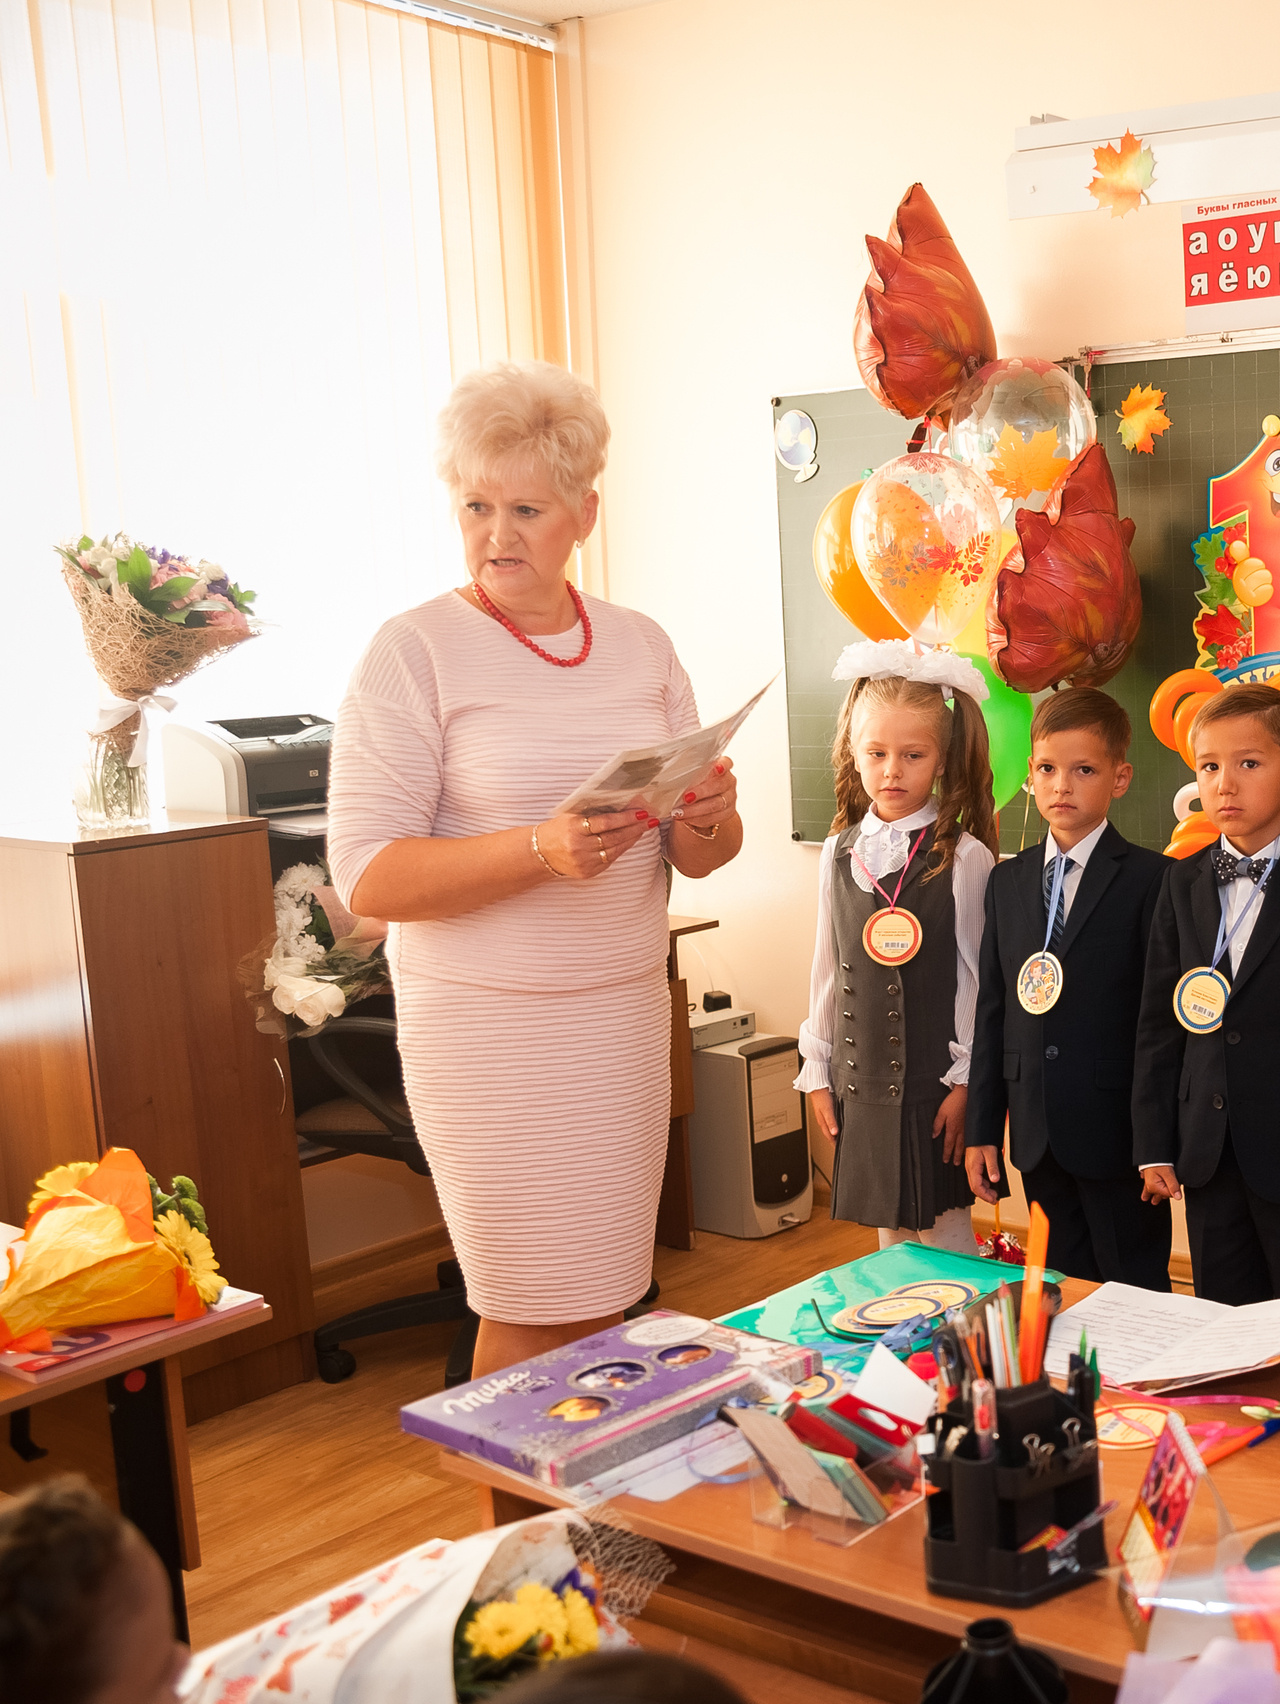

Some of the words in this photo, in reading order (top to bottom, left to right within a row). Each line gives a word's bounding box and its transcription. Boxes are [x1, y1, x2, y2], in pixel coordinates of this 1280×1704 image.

[1197, 203, 1229, 215] Буквы
[1232, 196, 1277, 209] гласных
[442, 1370, 531, 1415] Milka
